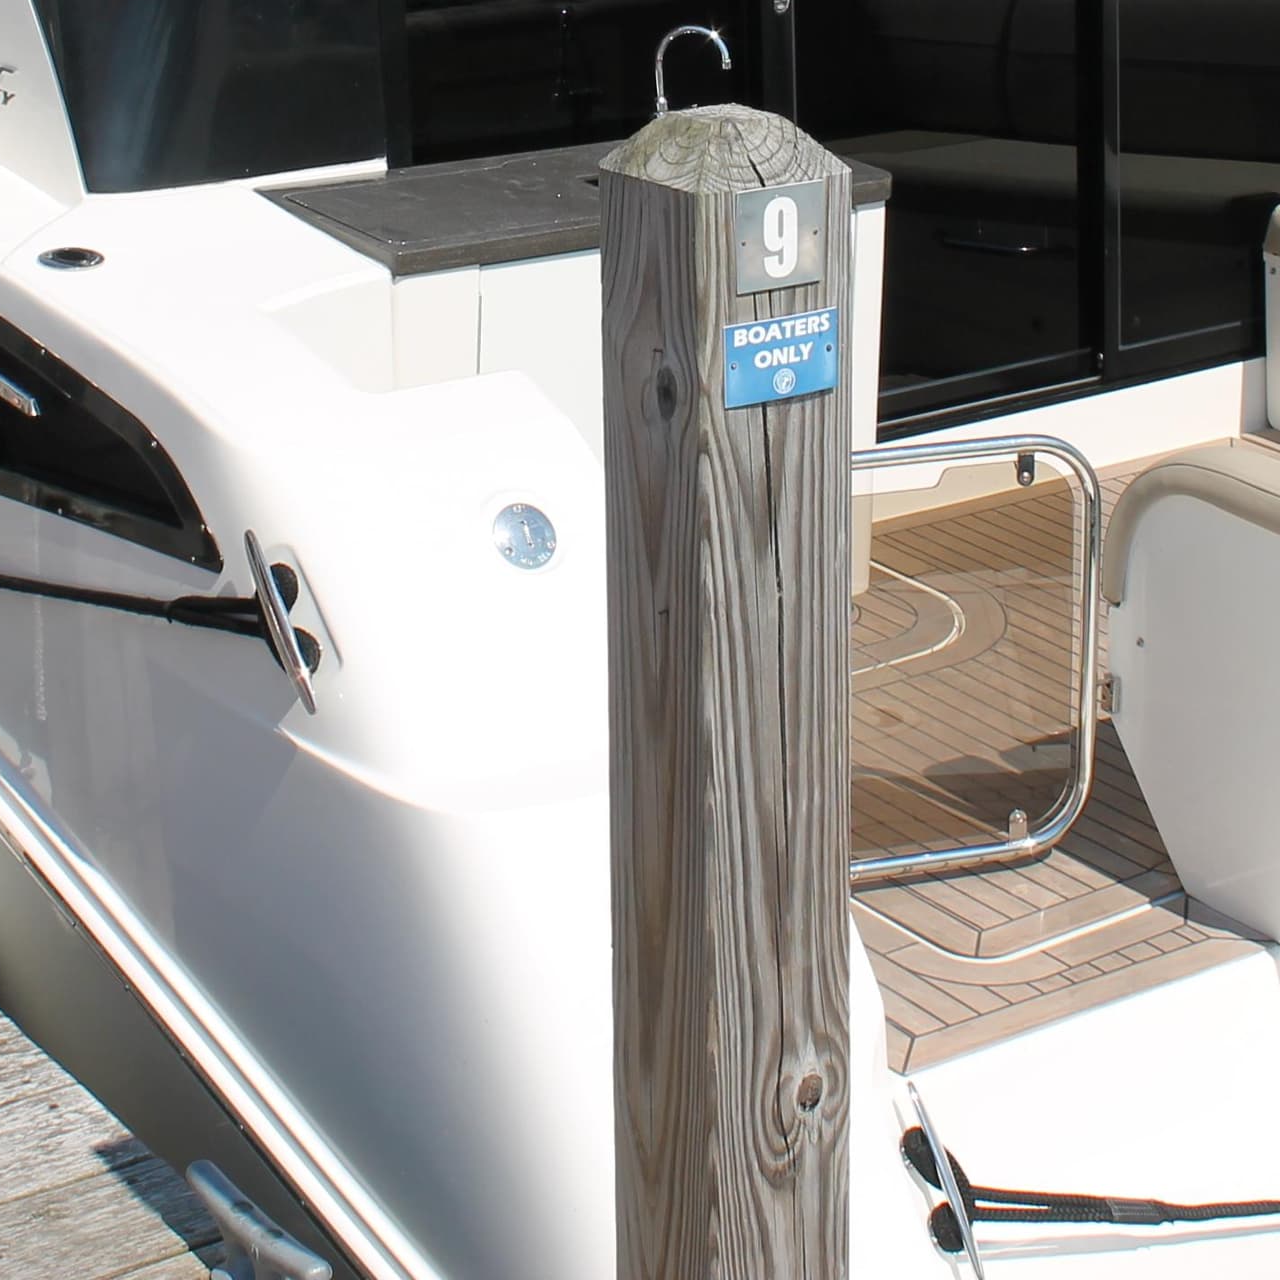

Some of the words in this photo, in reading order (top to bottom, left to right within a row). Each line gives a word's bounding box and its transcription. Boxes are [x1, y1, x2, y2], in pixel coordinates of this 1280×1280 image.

[763, 196, 799, 279] 9
[733, 312, 831, 348] BOATERS
[753, 342, 814, 370] ONLY
